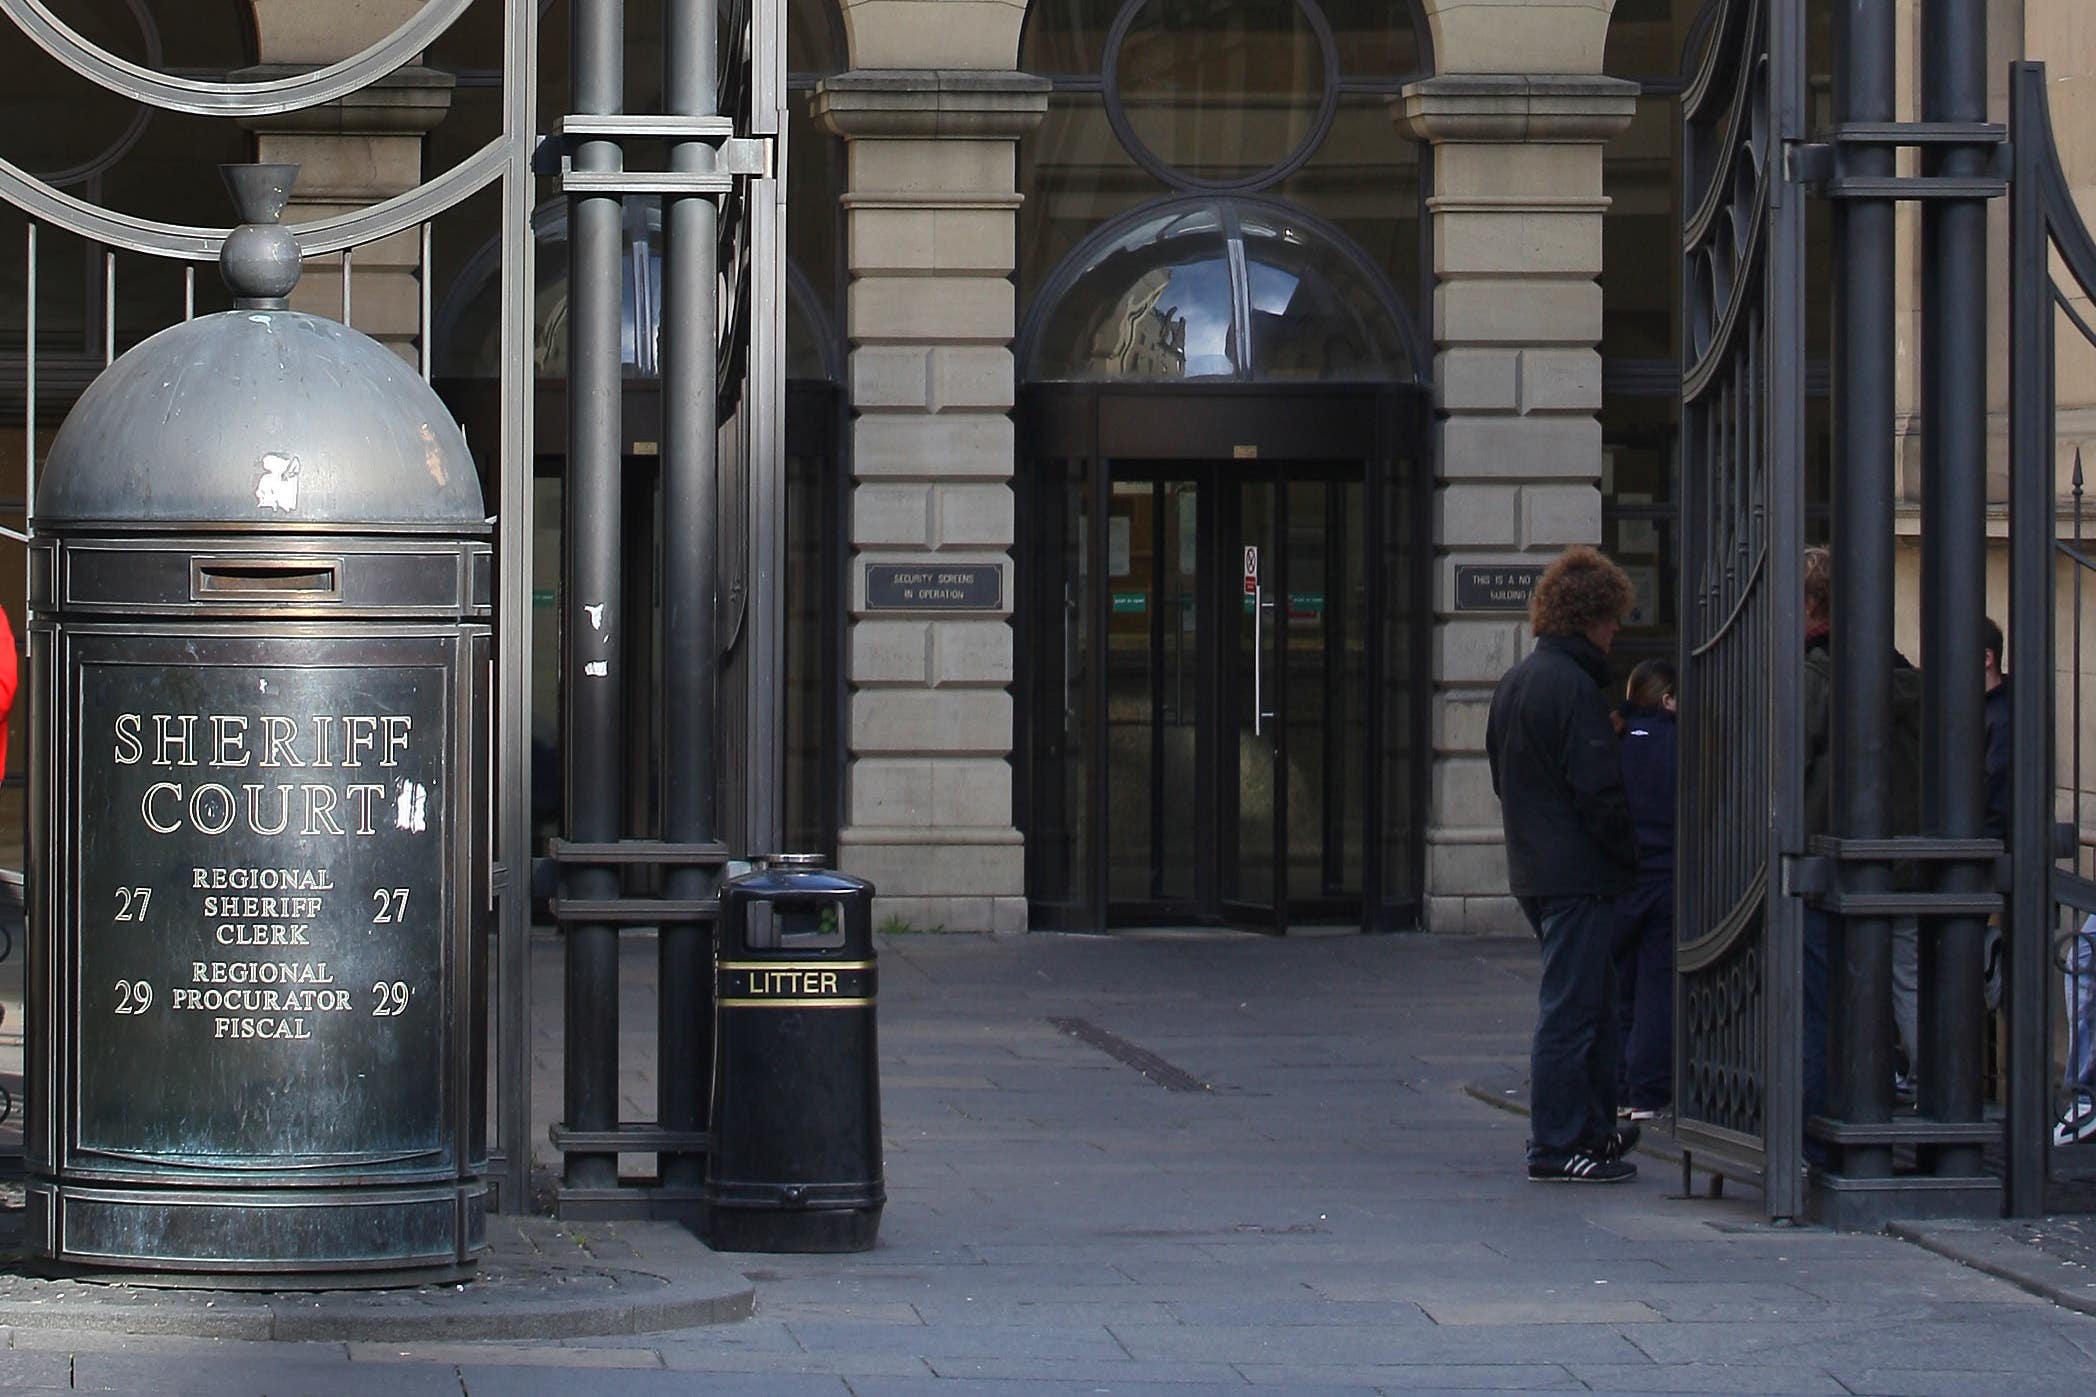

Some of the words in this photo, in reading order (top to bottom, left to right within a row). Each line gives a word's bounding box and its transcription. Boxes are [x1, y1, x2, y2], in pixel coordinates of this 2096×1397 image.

[893, 573, 933, 584] SECURITY
[938, 573, 975, 584] SCREENS
[1473, 575, 1490, 585] THIS
[1495, 575, 1503, 585] IS
[1508, 575, 1515, 585] A
[1519, 575, 1531, 585] NO
[904, 589, 913, 600] IN
[918, 589, 965, 600] OPERATION
[114, 713, 412, 767] SHERIFF
[141, 782, 386, 835] COURT
[192, 868, 334, 890] REGIONAL
[114, 886, 152, 922] 27
[204, 897, 323, 918] SHERIFF
[372, 888, 410, 924] 27
[216, 924, 310, 945] CLERK
[192, 962, 334, 984] REGIONAL
[749, 972, 838, 994] LITTER
[114, 979, 153, 1015] 29
[172, 989, 353, 1011] PROCURATOR
[372, 981, 409, 1016] 29
[214, 1017, 312, 1039] FISCAL
